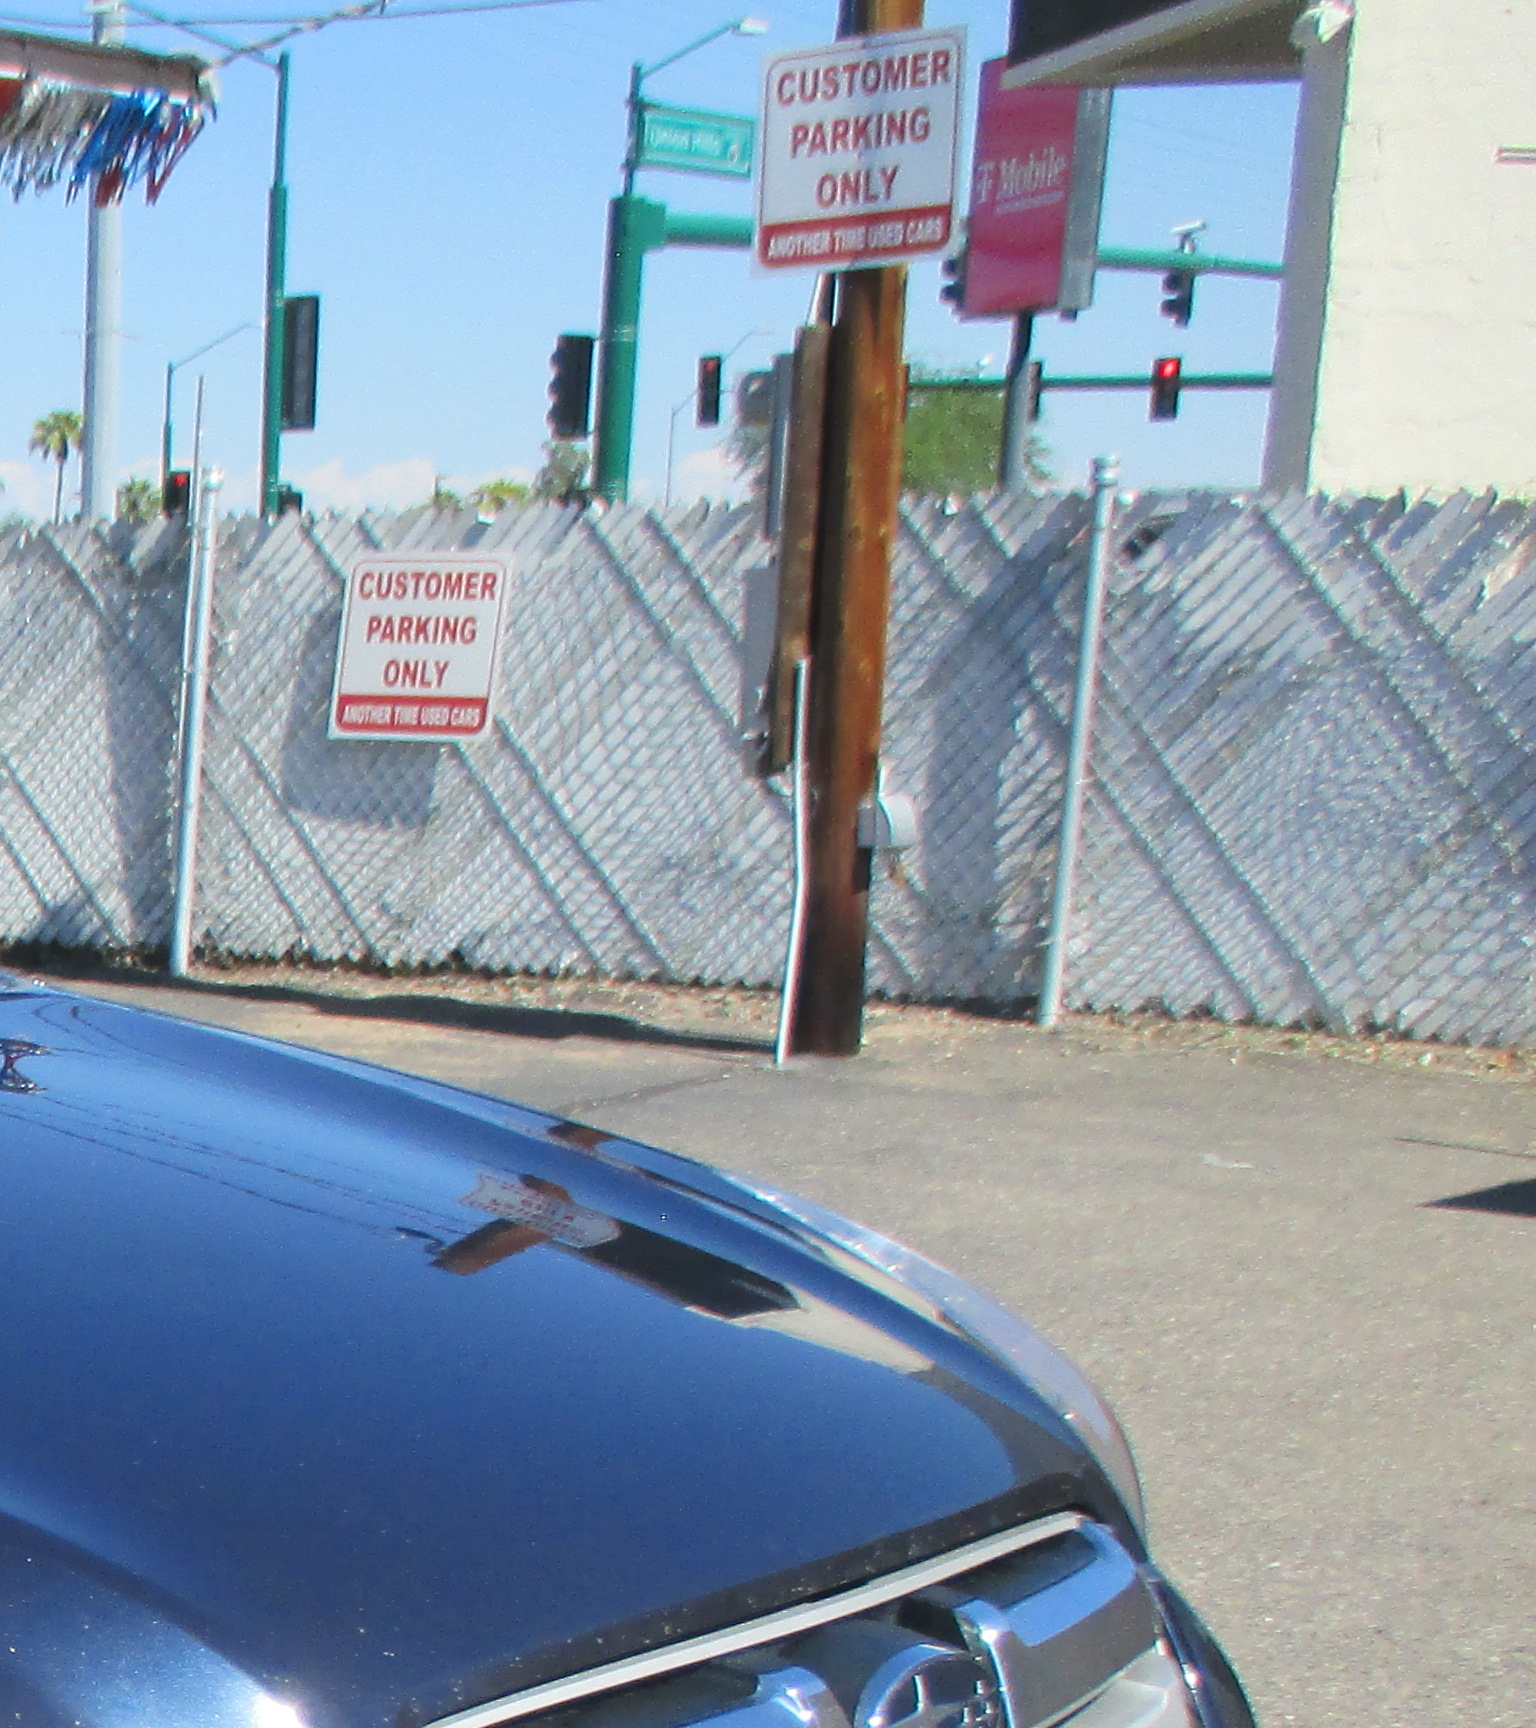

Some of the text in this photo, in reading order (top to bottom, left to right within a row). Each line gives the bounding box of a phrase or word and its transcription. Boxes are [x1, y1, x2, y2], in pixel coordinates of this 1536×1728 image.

[777, 50, 950, 107] CUSTOMER
[789, 106, 931, 159] PARKING
[816, 163, 901, 207] ONLY
[996, 146, 1067, 199] Mobile
[767, 216, 943, 260] ANOTHER TIME USED CARS
[359, 571, 498, 601] CUSTOMER
[365, 615, 478, 645] PARKING
[382, 659, 451, 689] ONLY
[341, 704, 481, 728] ANOTHER TIME USED CARS
